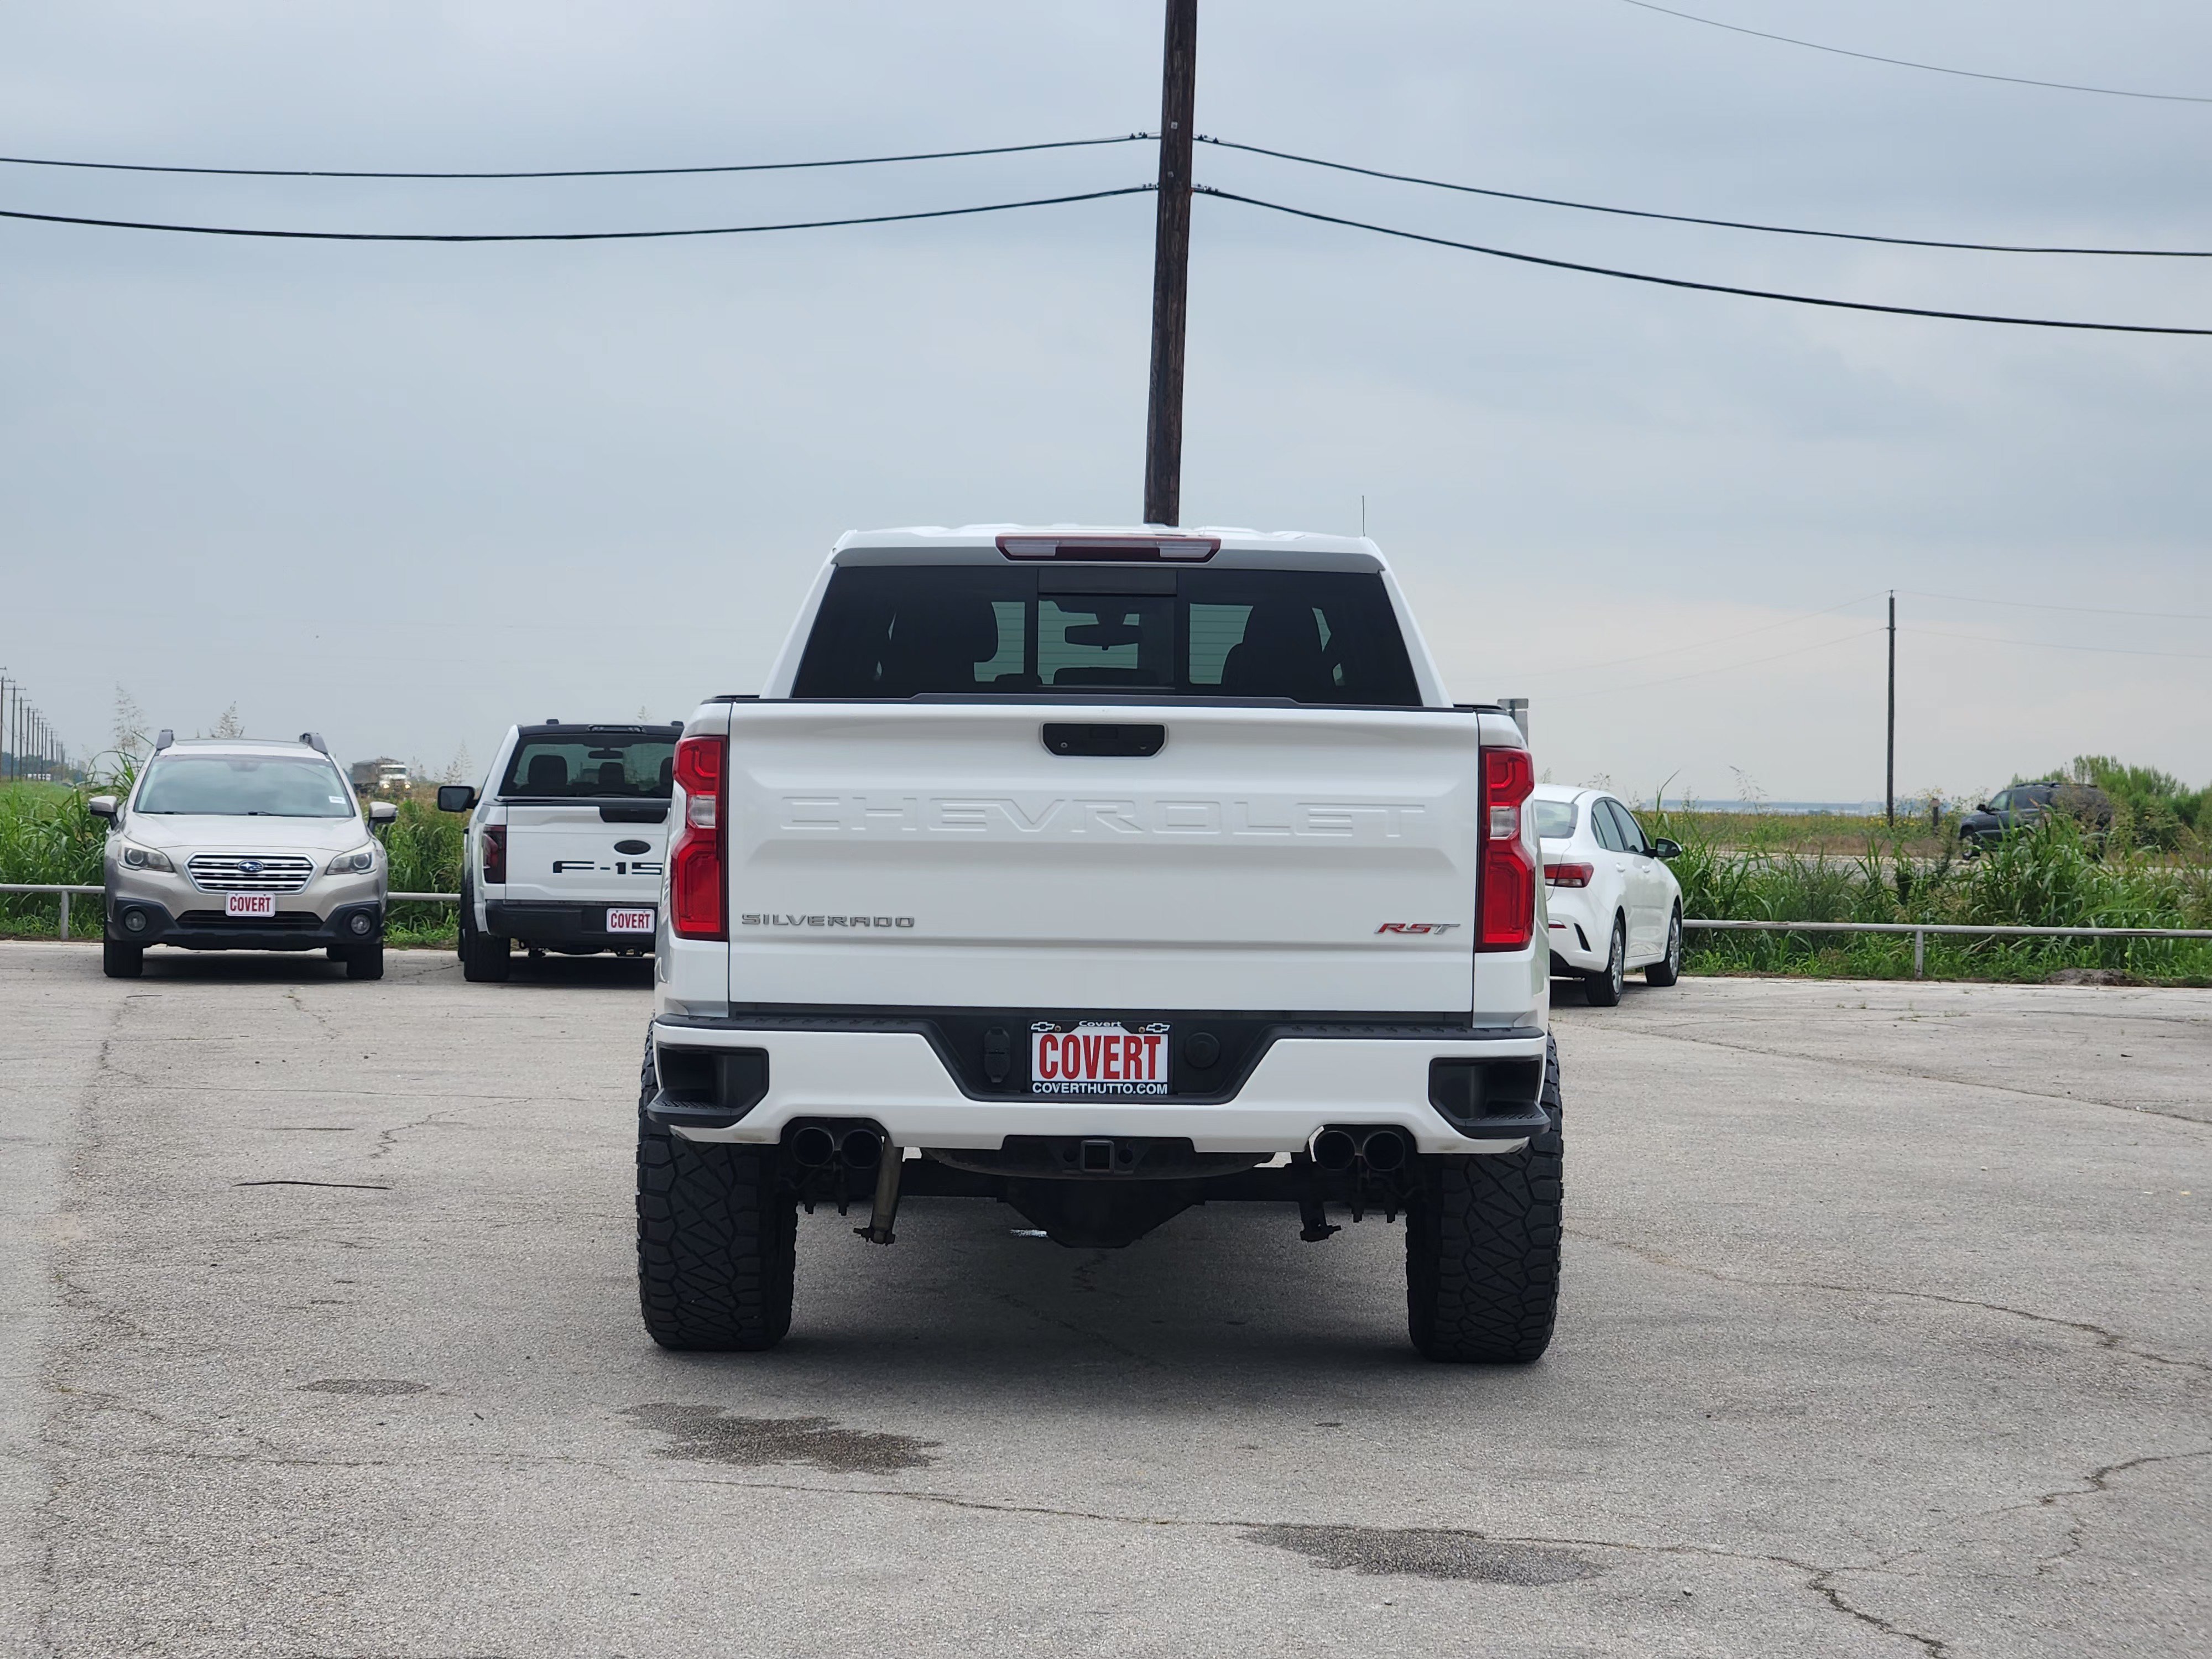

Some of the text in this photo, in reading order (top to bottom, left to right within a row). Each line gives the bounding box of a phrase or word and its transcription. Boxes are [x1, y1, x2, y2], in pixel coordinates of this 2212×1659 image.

[780, 796, 1426, 837] CHEVROLET
[553, 860, 664, 875] F-15
[230, 896, 271, 912] COVERT
[611, 913, 650, 928] COVERT
[742, 913, 915, 927] SILVERADO
[1374, 923, 1461, 935] RST
[1039, 1034, 1161, 1080] COVERT
[1032, 1082, 1168, 1094] COVERTHUTTO.COM
